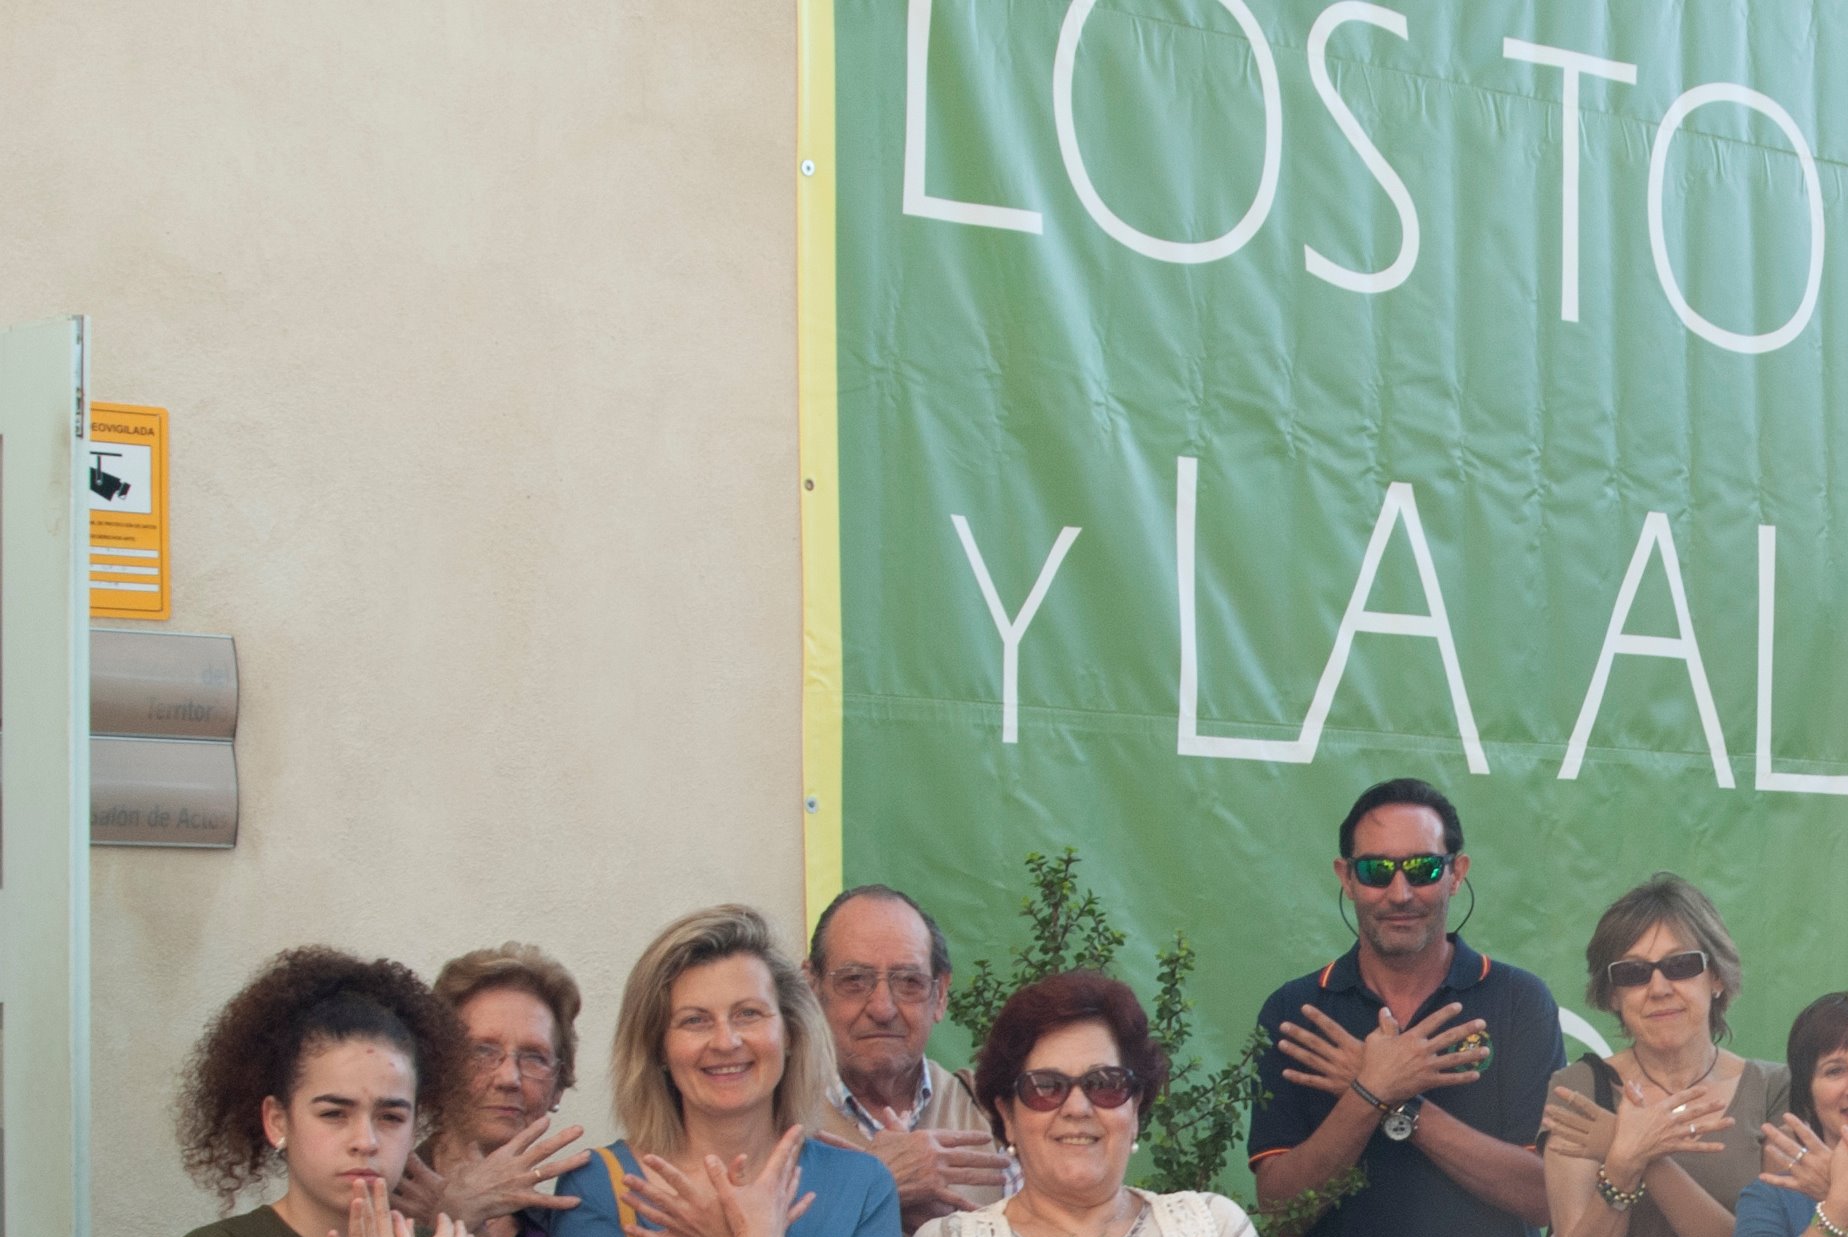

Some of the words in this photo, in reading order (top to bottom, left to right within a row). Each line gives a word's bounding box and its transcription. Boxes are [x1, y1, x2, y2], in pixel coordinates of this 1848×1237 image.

[903, 0, 1420, 294] LOS
[950, 513, 1082, 744] Y
[1176, 456, 1491, 776] LA
